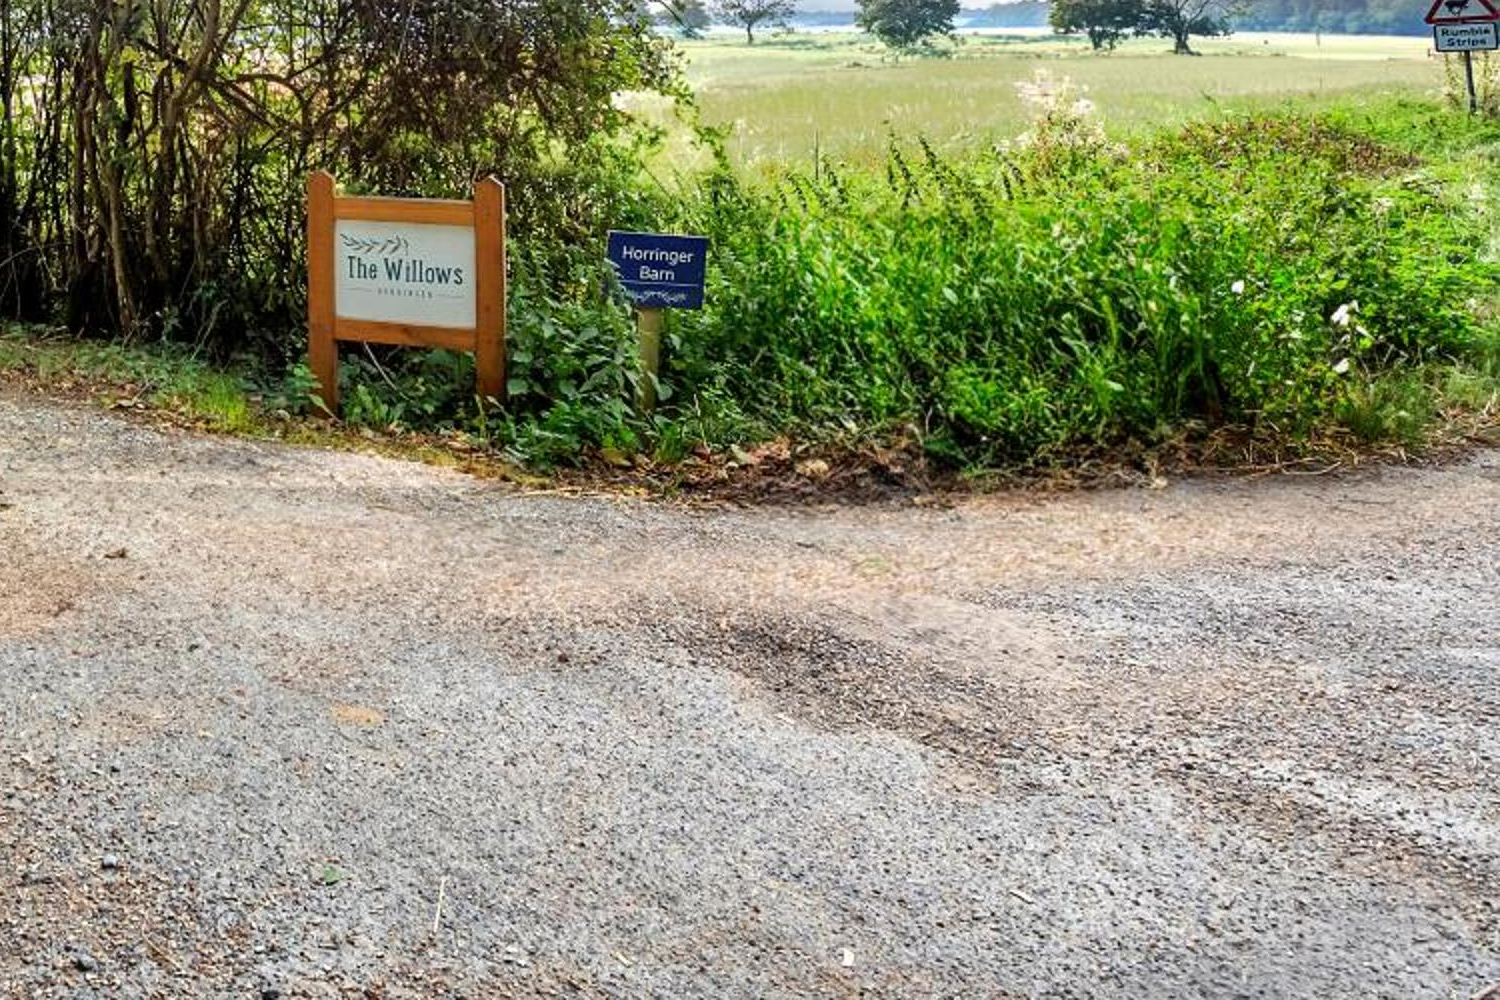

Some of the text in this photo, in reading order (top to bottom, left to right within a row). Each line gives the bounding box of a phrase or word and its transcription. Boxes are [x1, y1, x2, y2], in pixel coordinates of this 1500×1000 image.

[1441, 26, 1491, 38] Rumble
[1447, 37, 1487, 47] Strips
[622, 245, 694, 265] Horringer
[348, 255, 463, 285] The Willows
[639, 265, 675, 281] Barn
